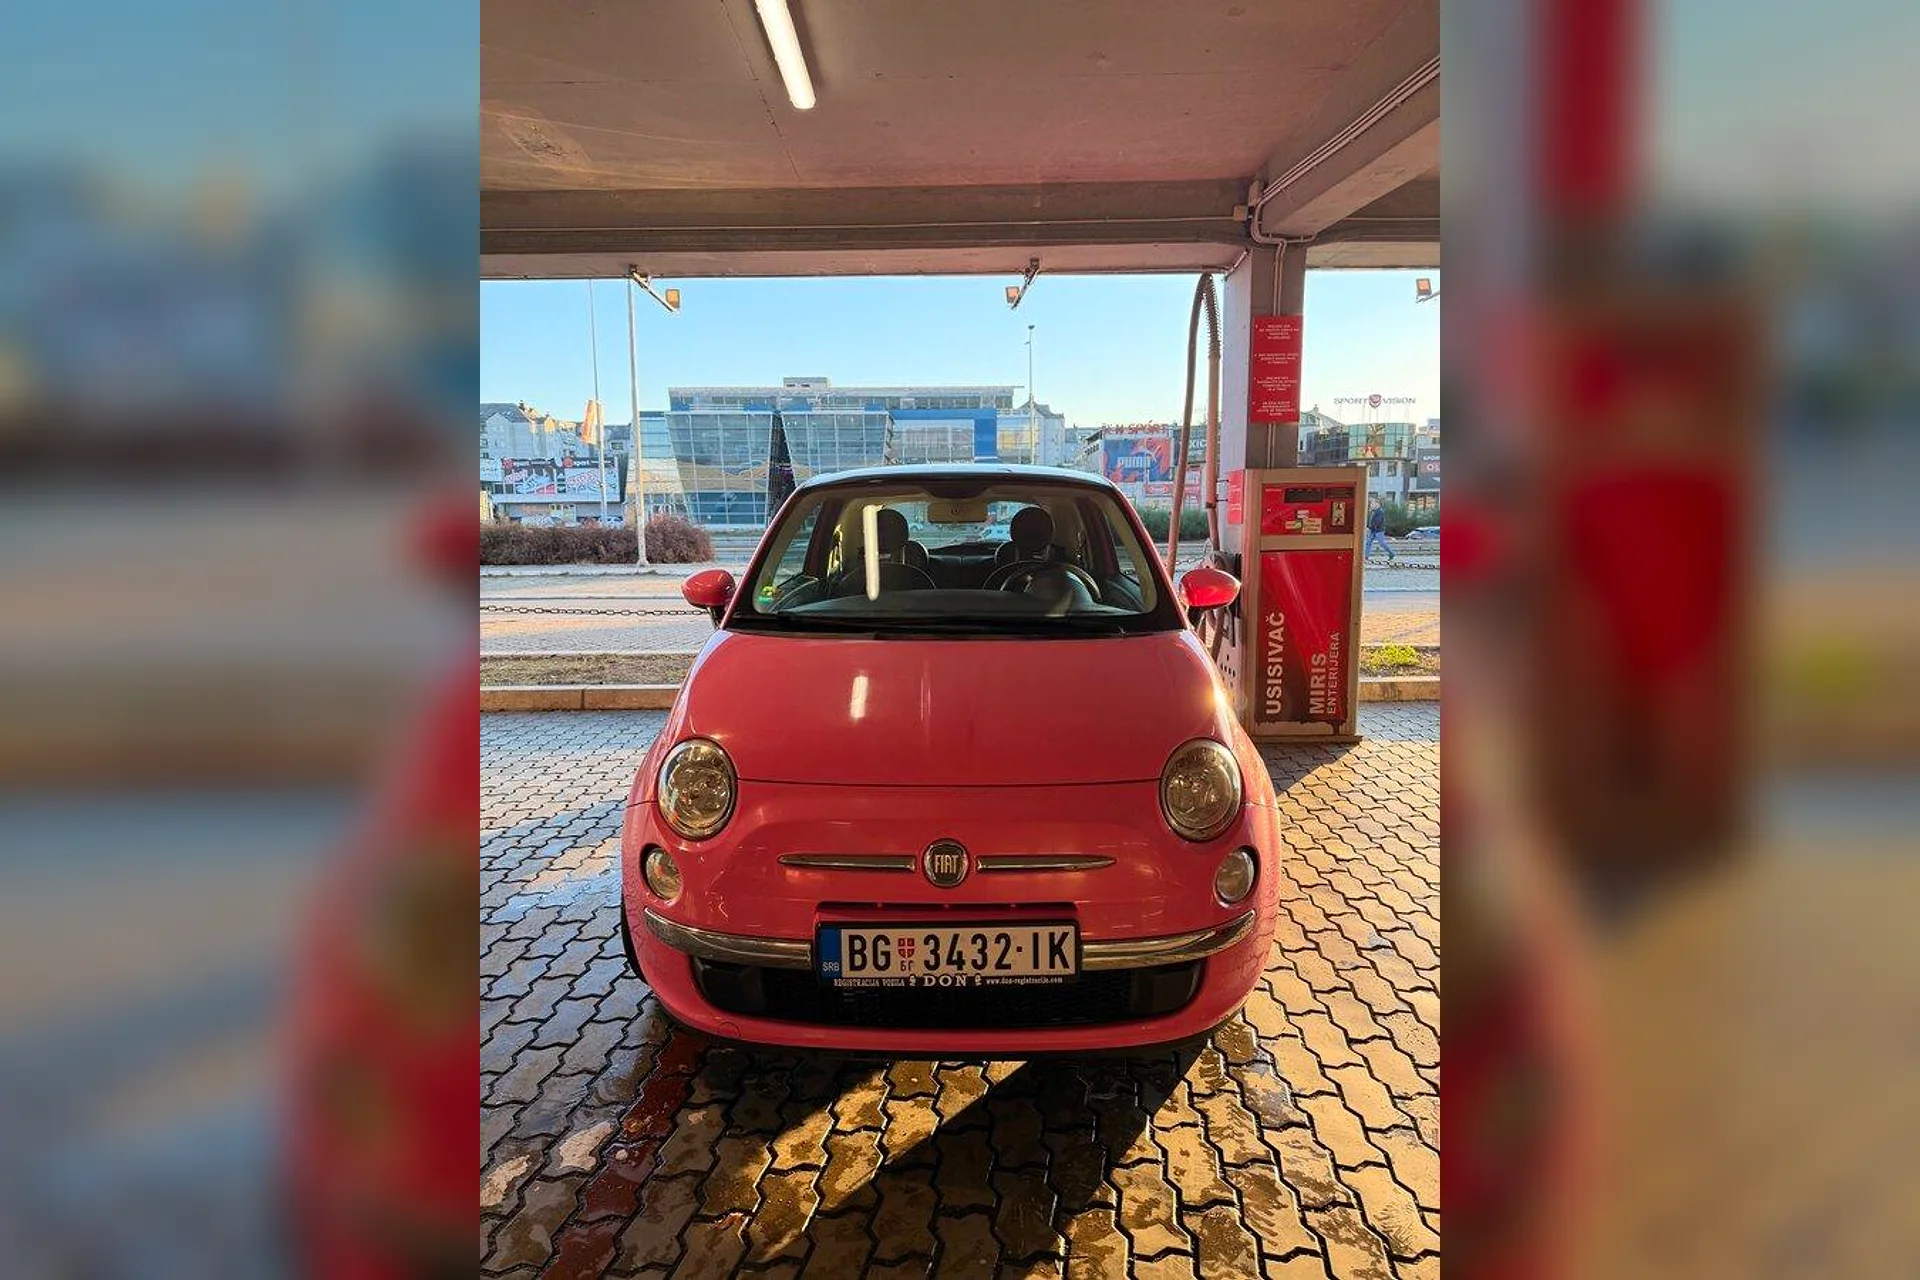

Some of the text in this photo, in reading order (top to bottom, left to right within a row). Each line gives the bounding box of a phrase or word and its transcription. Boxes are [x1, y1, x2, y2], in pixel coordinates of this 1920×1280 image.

[1333, 396, 1416, 405] SPORT VISION
[1265, 612, 1285, 714] USISIVAČ
[1327, 631, 1340, 714] ENTERIJERA
[1309, 653, 1326, 714] MIRIS
[934, 854, 959, 874] FIAT
[822, 961, 840, 972] SRB
[848, 934, 891, 972] BG
[923, 975, 967, 987] DON
